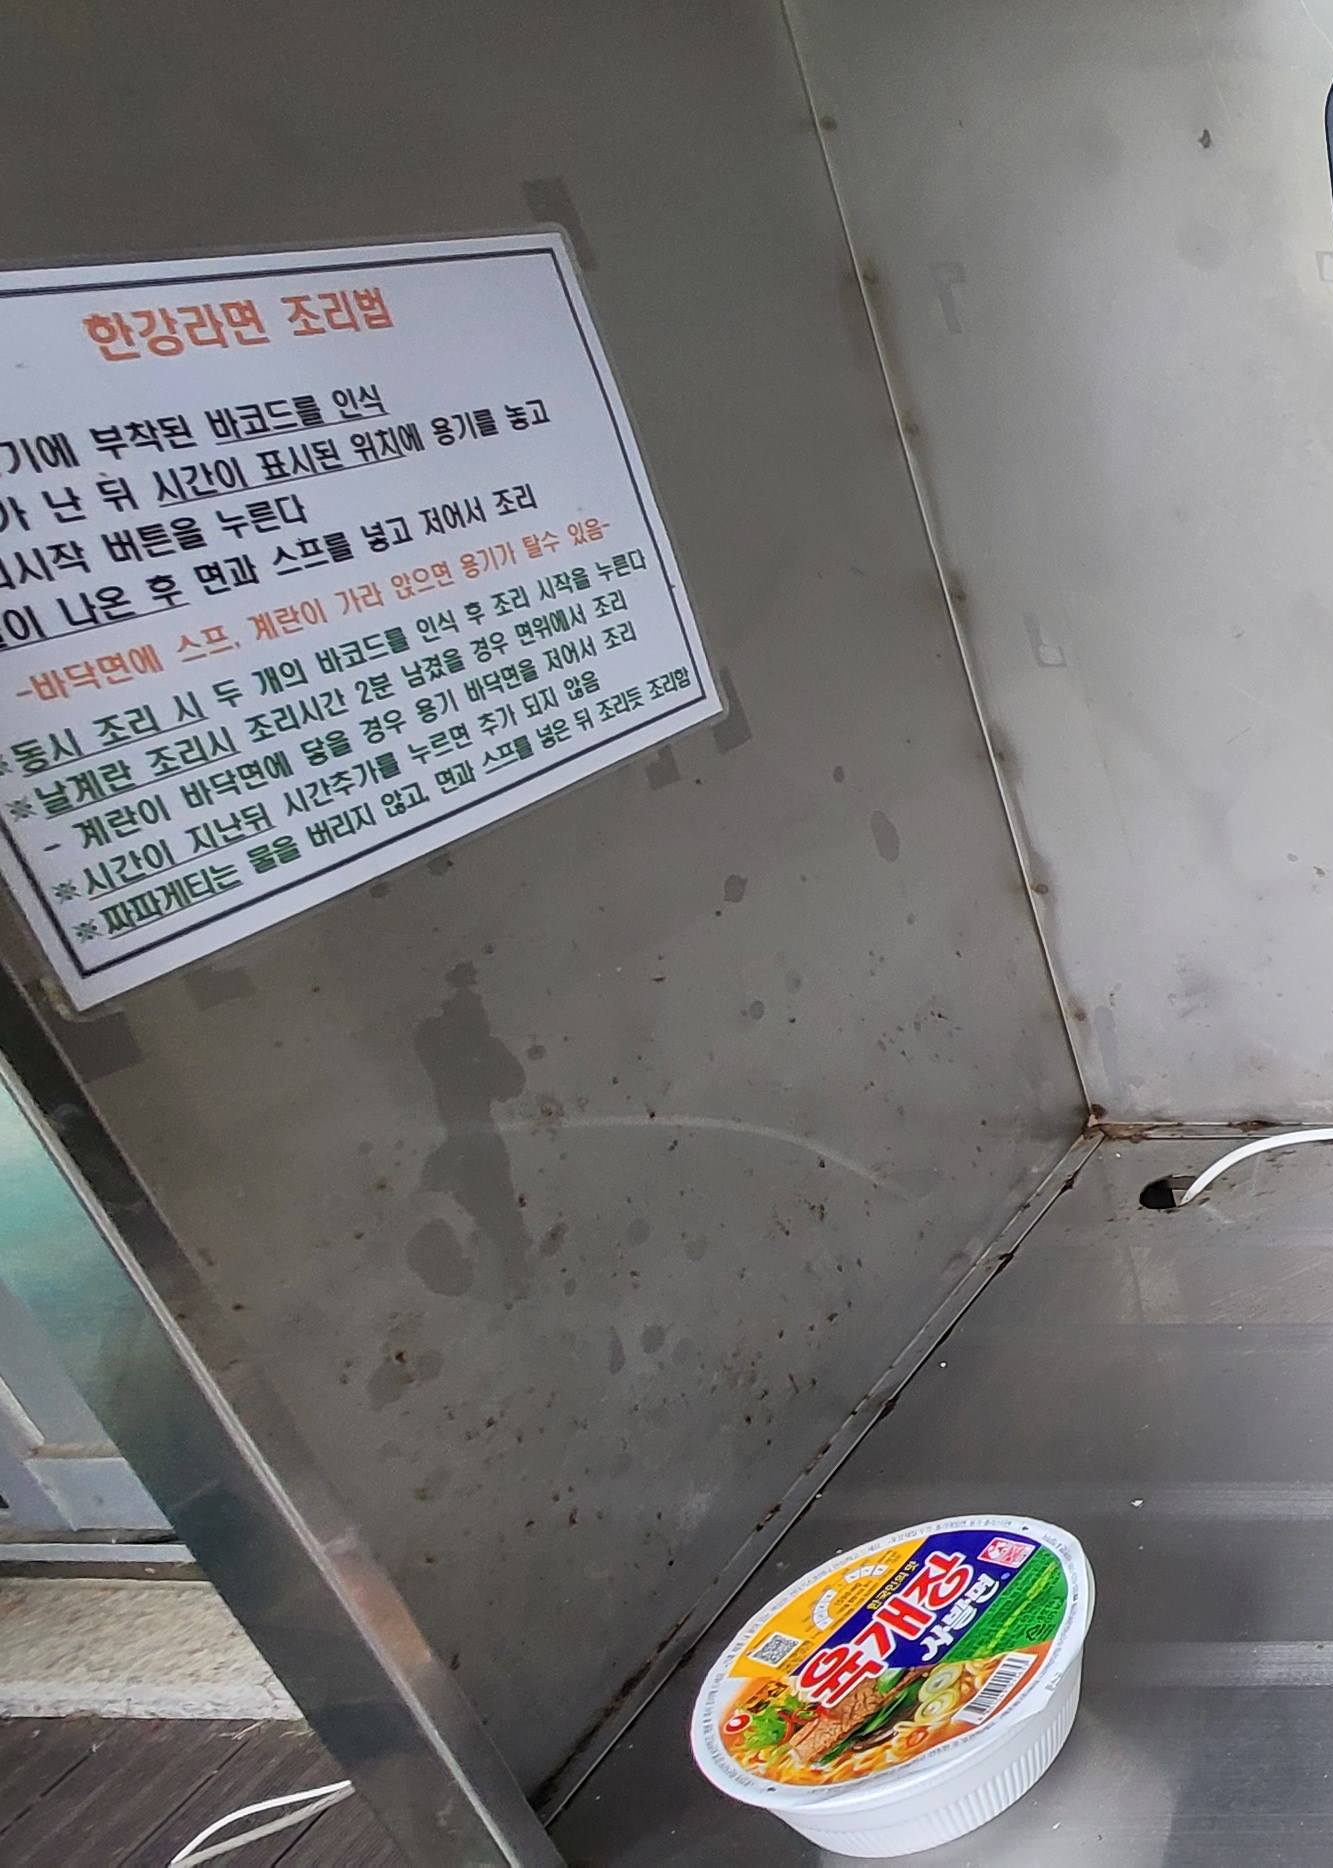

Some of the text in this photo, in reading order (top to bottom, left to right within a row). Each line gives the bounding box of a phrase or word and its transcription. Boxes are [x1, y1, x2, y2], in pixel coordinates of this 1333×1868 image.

[83, 287, 395, 362] 한강라면 조리법
[0, 384, 388, 475] 기에 부착된 바코드를 인식
[41, 487, 87, 524] 난
[96, 476, 139, 512] 뒤
[152, 456, 249, 501] 시간이
[256, 438, 345, 481] 표시된
[350, 423, 426, 461] 위치에
[430, 408, 500, 446] 용기를
[503, 398, 552, 431] 놓고
[55, 585, 137, 627] 나온
[145, 574, 184, 606] 후
[192, 554, 260, 596] 면과
[271, 531, 355, 576] 스프를
[360, 516, 414, 554] 넣고
[418, 495, 488, 538] 저어서
[491, 483, 539, 517] 조리
[100, 517, 208, 563] 버튼을
[215, 494, 309, 539] 누른다
[247, 598, 329, 641] 계란이
[334, 581, 385, 617] 가라
[390, 560, 454, 601] 앉으면
[458, 541, 518, 580] 용기가
[521, 530, 561, 560] 탈수
[91, 704, 161, 747] 조리
[173, 691, 206, 722] 시
[211, 678, 244, 708] 두
[251, 657, 309, 697] 개의
[314, 626, 411, 675] 바코드를
[415, 609, 460, 644] 인식
[463, 601, 487, 626] 후
[489, 585, 531, 617] 조리
[536, 566, 592, 602] 시작을
[594, 548, 648, 582] 누른다
[144, 726, 238, 777] 조리시
[244, 688, 349, 743] 조리시간
[354, 672, 396, 706] 2분
[469, 631, 510, 664] 경우
[514, 603, 589, 647] 면위에서
[593, 589, 629, 619] 조리
[246, 834, 303, 875] 물을
[304, 801, 378, 848] 버리지
[434, 763, 478, 795] 면과
[480, 732, 536, 776] 스프를
[535, 717, 573, 750] 넣은
[573, 707, 596, 734] 뒤
[597, 686, 645, 724] 조리듯
[646, 666, 693, 702] 조리함
[798, 1551, 968, 1709] 육개장
[867, 1572, 908, 1611] 한국인의
[919, 1573, 1000, 1661] 사발면
